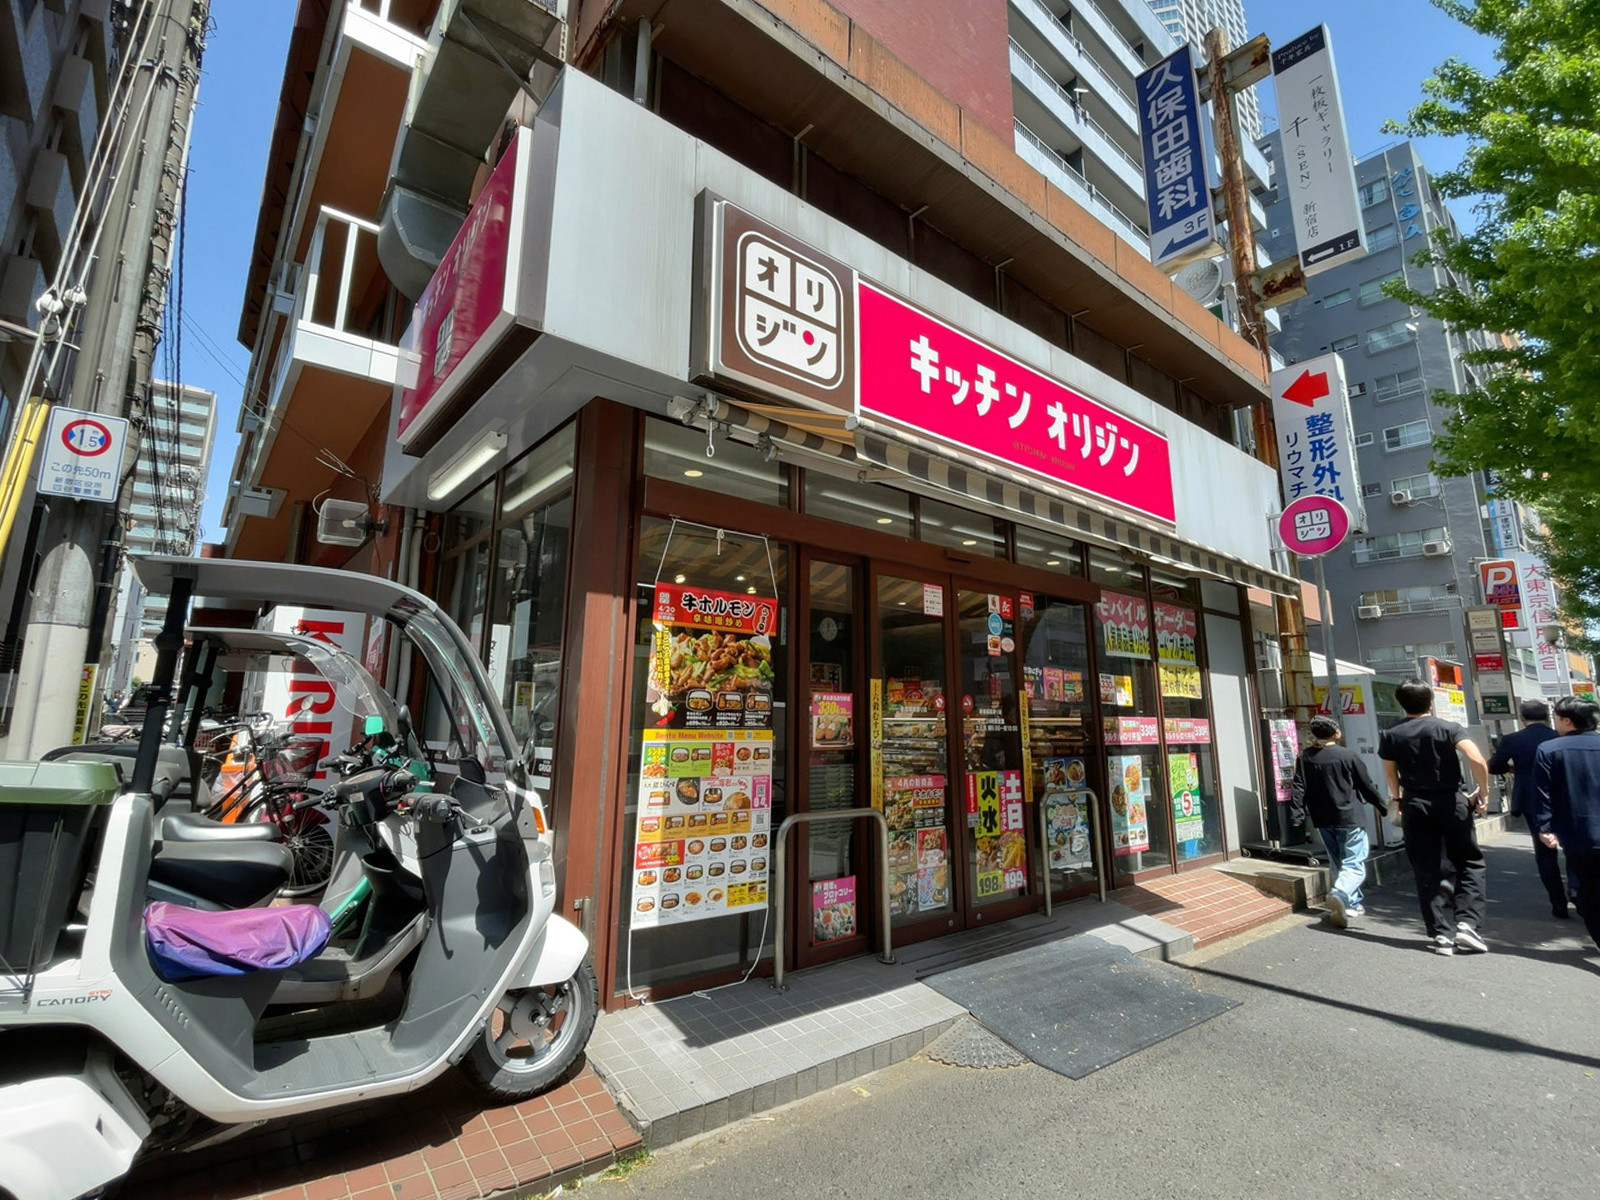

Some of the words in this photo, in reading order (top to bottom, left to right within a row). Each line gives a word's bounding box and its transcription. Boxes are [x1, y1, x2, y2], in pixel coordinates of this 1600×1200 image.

[1308, 75, 1333, 173] 一枚板ギャラリー
[1146, 60, 1198, 220] 久保田歯科
[1184, 214, 1207, 234] 3F
[1303, 201, 1319, 238] 新宿店
[1339, 239, 1355, 251] 1F
[909, 334, 1031, 429] キッチン
[1046, 401, 1139, 477] オリジン
[1286, 432, 1308, 498] リウマチ
[1305, 411, 1344, 502] 整形外科
[51, 462, 111, 480] この先50m
[1486, 566, 1513, 596] P
[681, 592, 755, 618] 牛ホルモン
[1097, 596, 1147, 622] モバイル
[1154, 607, 1195, 630] オーダー
[1321, 691, 1360, 712] 10円
[898, 777, 934, 788] 4月の新商品
[823, 887, 853, 900] ブロッコリー
[37, 994, 111, 1007] CANOPY
